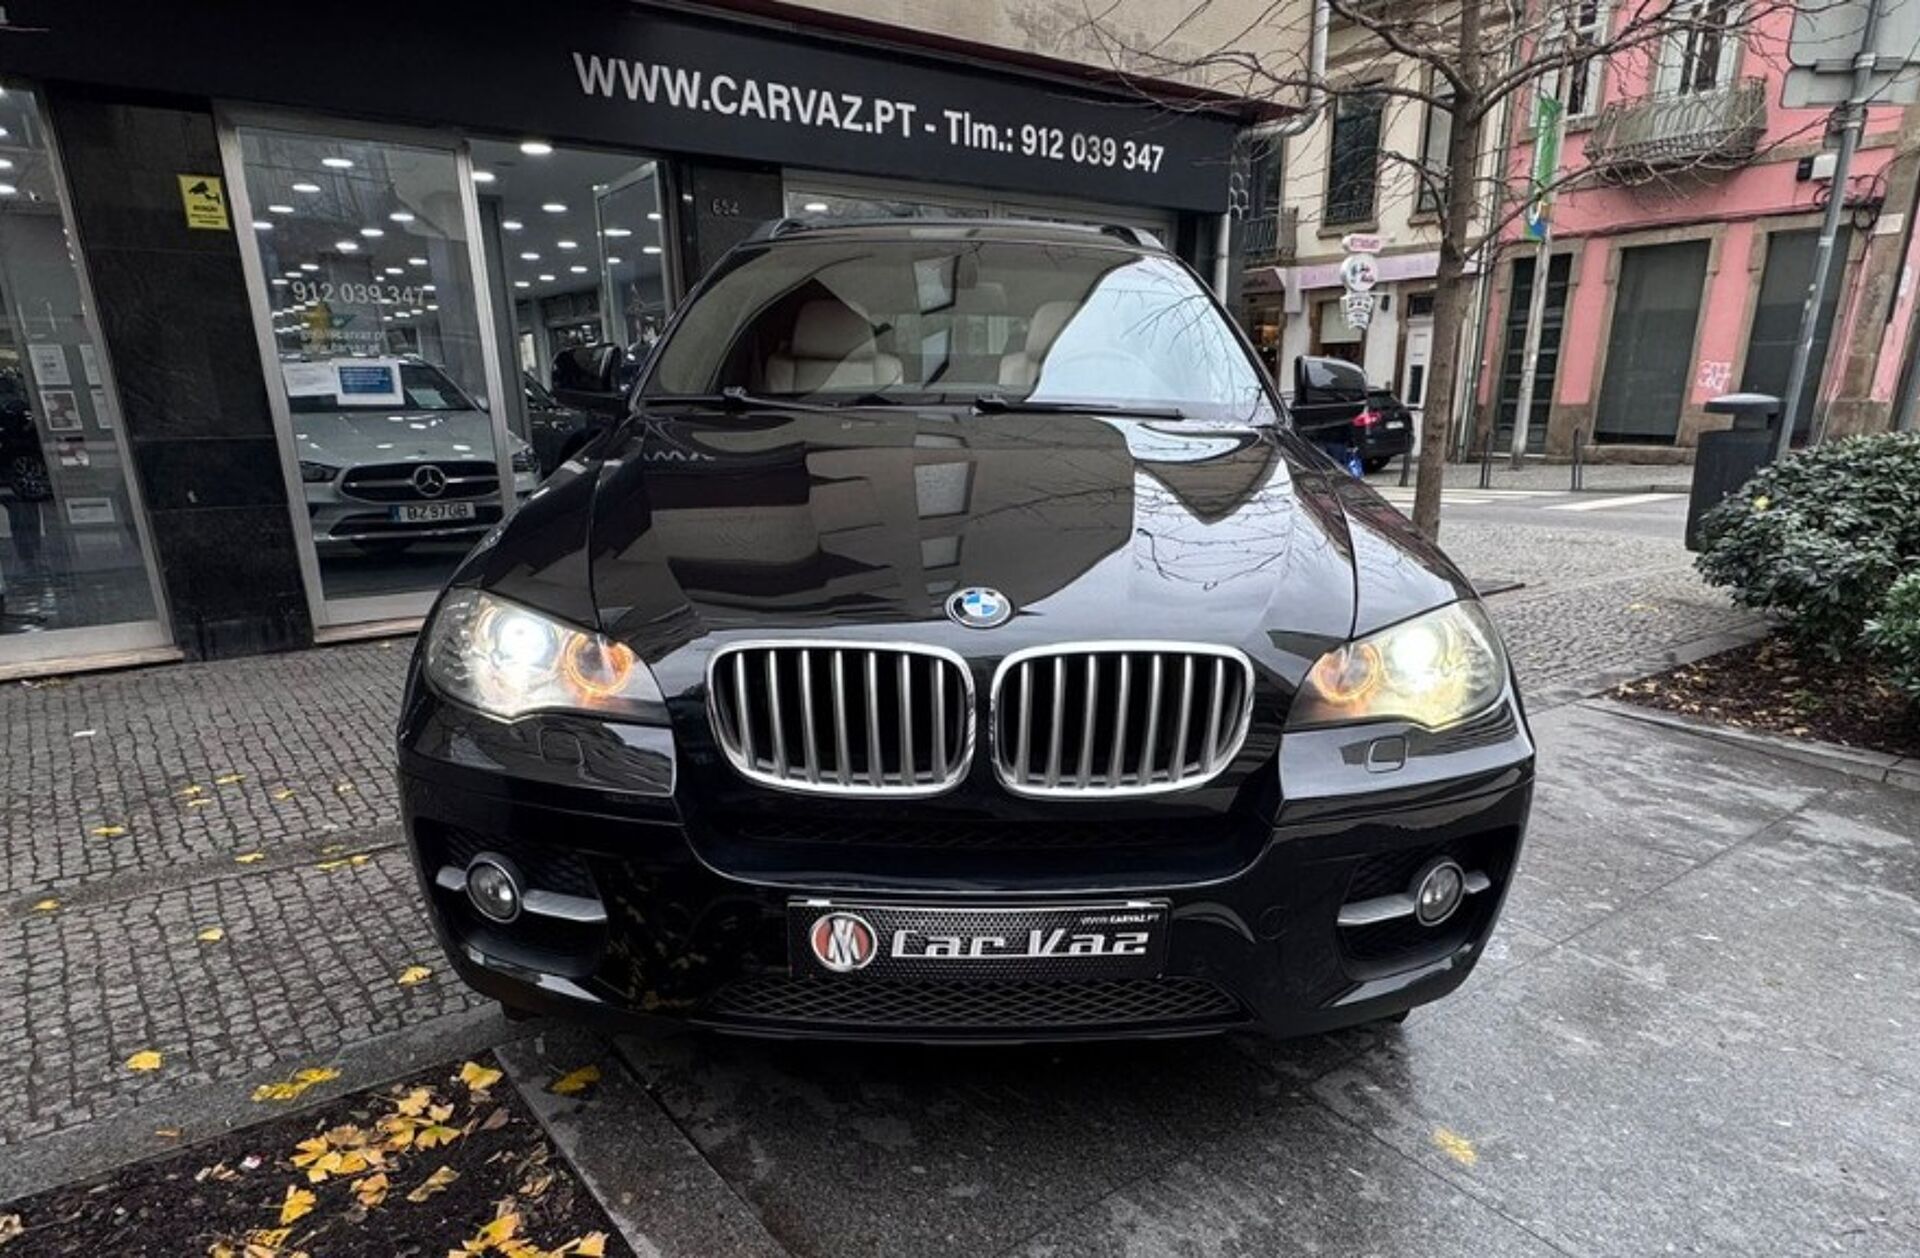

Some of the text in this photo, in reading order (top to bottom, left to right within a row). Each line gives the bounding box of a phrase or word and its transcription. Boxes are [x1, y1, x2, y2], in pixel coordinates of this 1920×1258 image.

[572, 51, 916, 138] WWW.CARVAZ.PT
[943, 109, 1013, 153] Tlm.:
[1021, 124, 1064, 159] 912
[1071, 132, 1116, 167] 039
[1123, 140, 1164, 173] 347
[292, 281, 424, 306] 912 039 347
